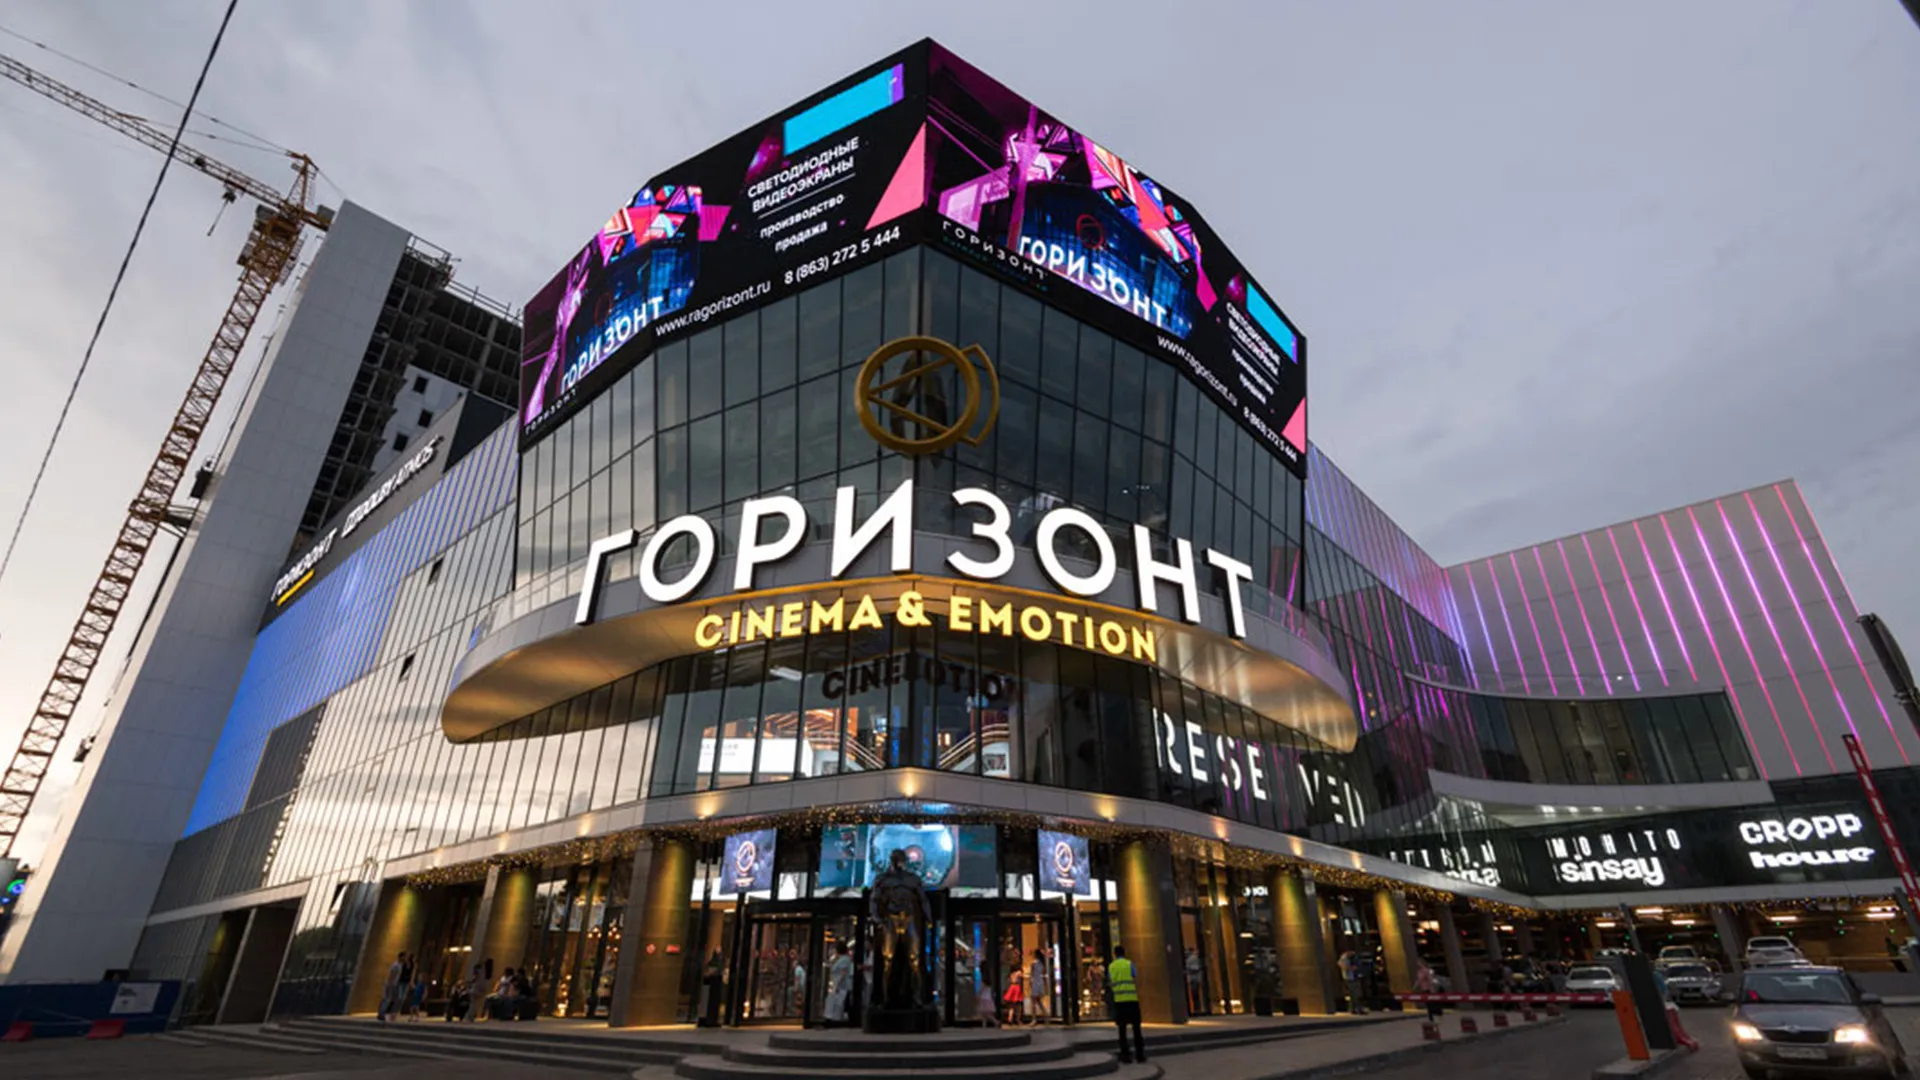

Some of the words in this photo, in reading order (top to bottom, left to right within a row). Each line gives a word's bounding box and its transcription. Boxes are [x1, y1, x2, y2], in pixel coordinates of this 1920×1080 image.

[747, 136, 860, 198] СВЕТОДИОДНЫЕ
[752, 156, 855, 213] ВИДЕОЭКРАНЫ
[760, 194, 845, 238] производство
[775, 221, 828, 252] продажа
[655, 279, 772, 336] www.ragorizont.ru
[784, 270, 793, 285] 8
[796, 255, 829, 282] (863)
[832, 244, 858, 265] 272
[860, 239, 871, 254] 5
[873, 226, 900, 247] 444
[943, 220, 1045, 280] ГОРИЗОНТ
[1019, 236, 1167, 328] ГОРИЗОНТ
[561, 296, 664, 395] ГОРИЗОНТ
[574, 478, 1253, 640] ГОРИЗОНТ
[694, 594, 884, 648] CINEMA
[895, 590, 932, 628] &
[949, 597, 1157, 663] EMOTION
[1153, 707, 1365, 829] RESEVED
[1549, 828, 1681, 859] MOHITO
[1739, 813, 1863, 845] CROPP
